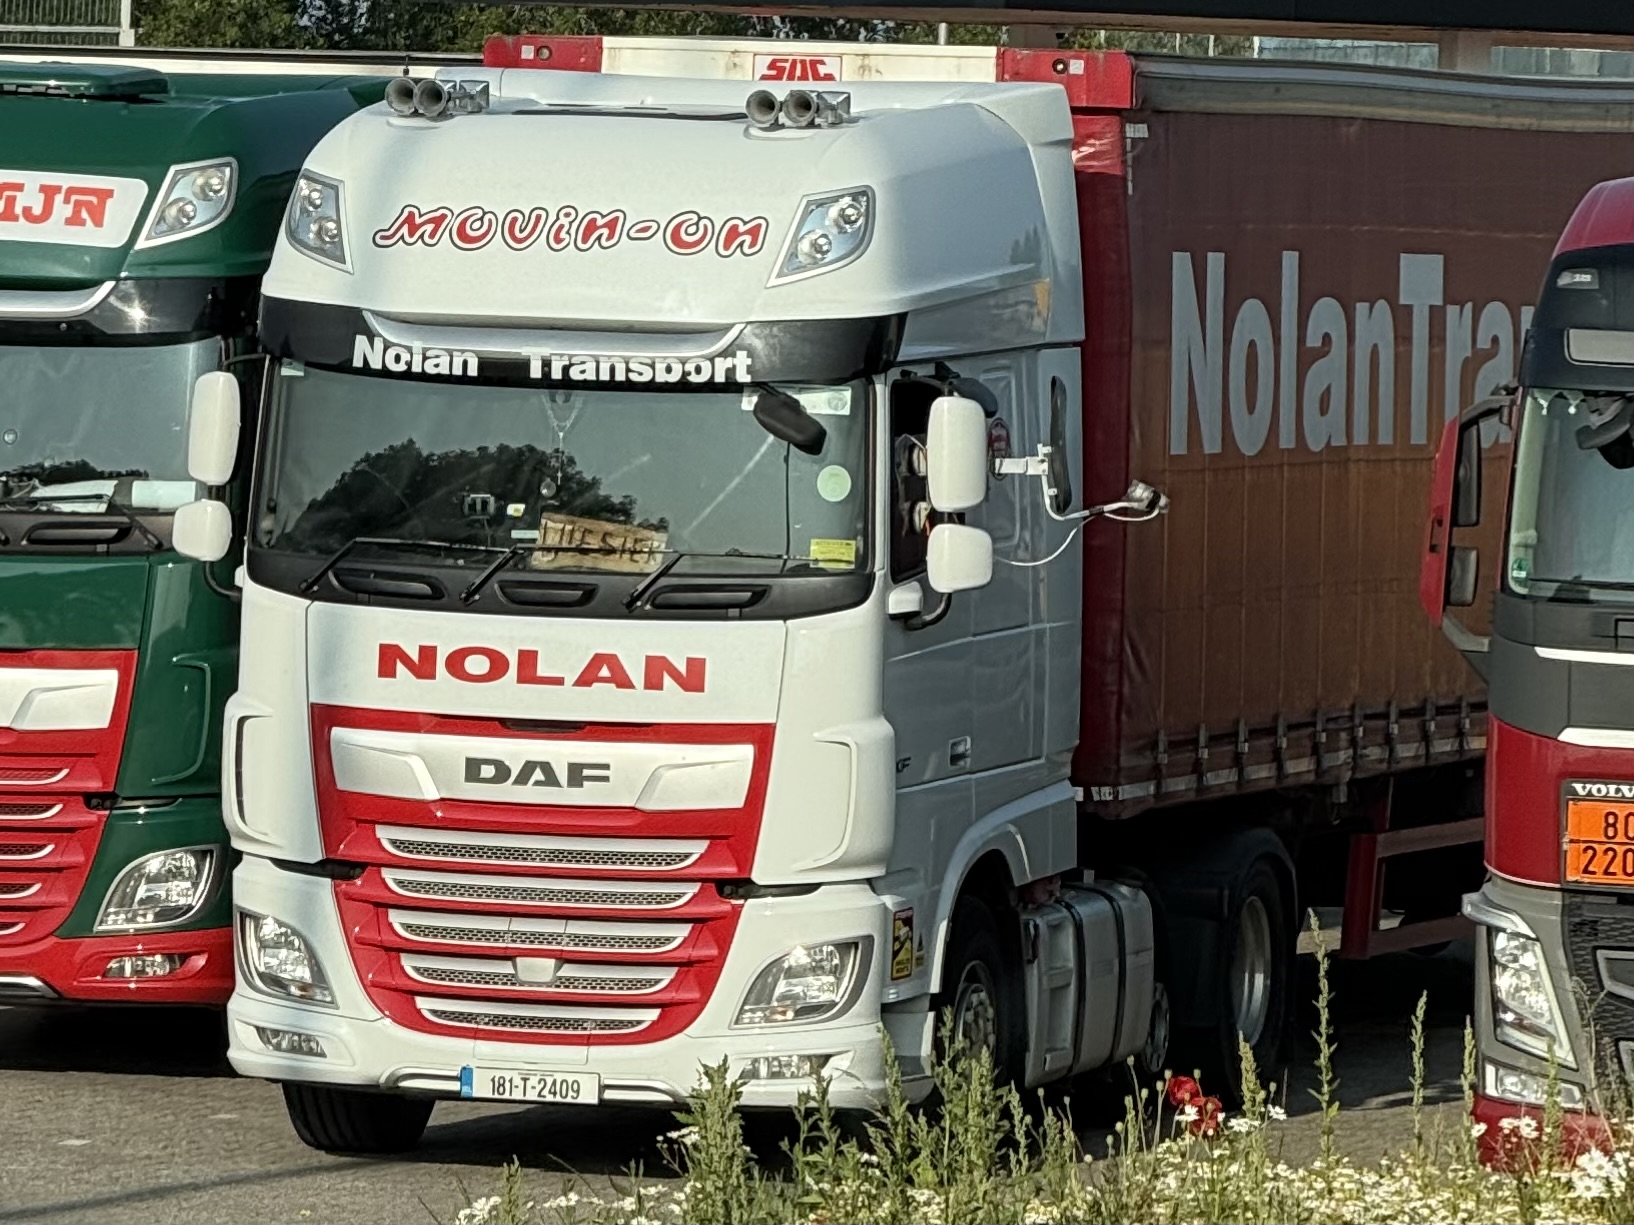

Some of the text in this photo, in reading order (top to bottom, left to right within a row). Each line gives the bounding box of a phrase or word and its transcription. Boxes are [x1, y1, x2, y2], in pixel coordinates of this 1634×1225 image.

[352, 334, 752, 384] Nolan Transport
[377, 642, 706, 693] NOLAN
[464, 756, 611, 788] DAF
[490, 1075, 581, 1100] 181-T-2409
